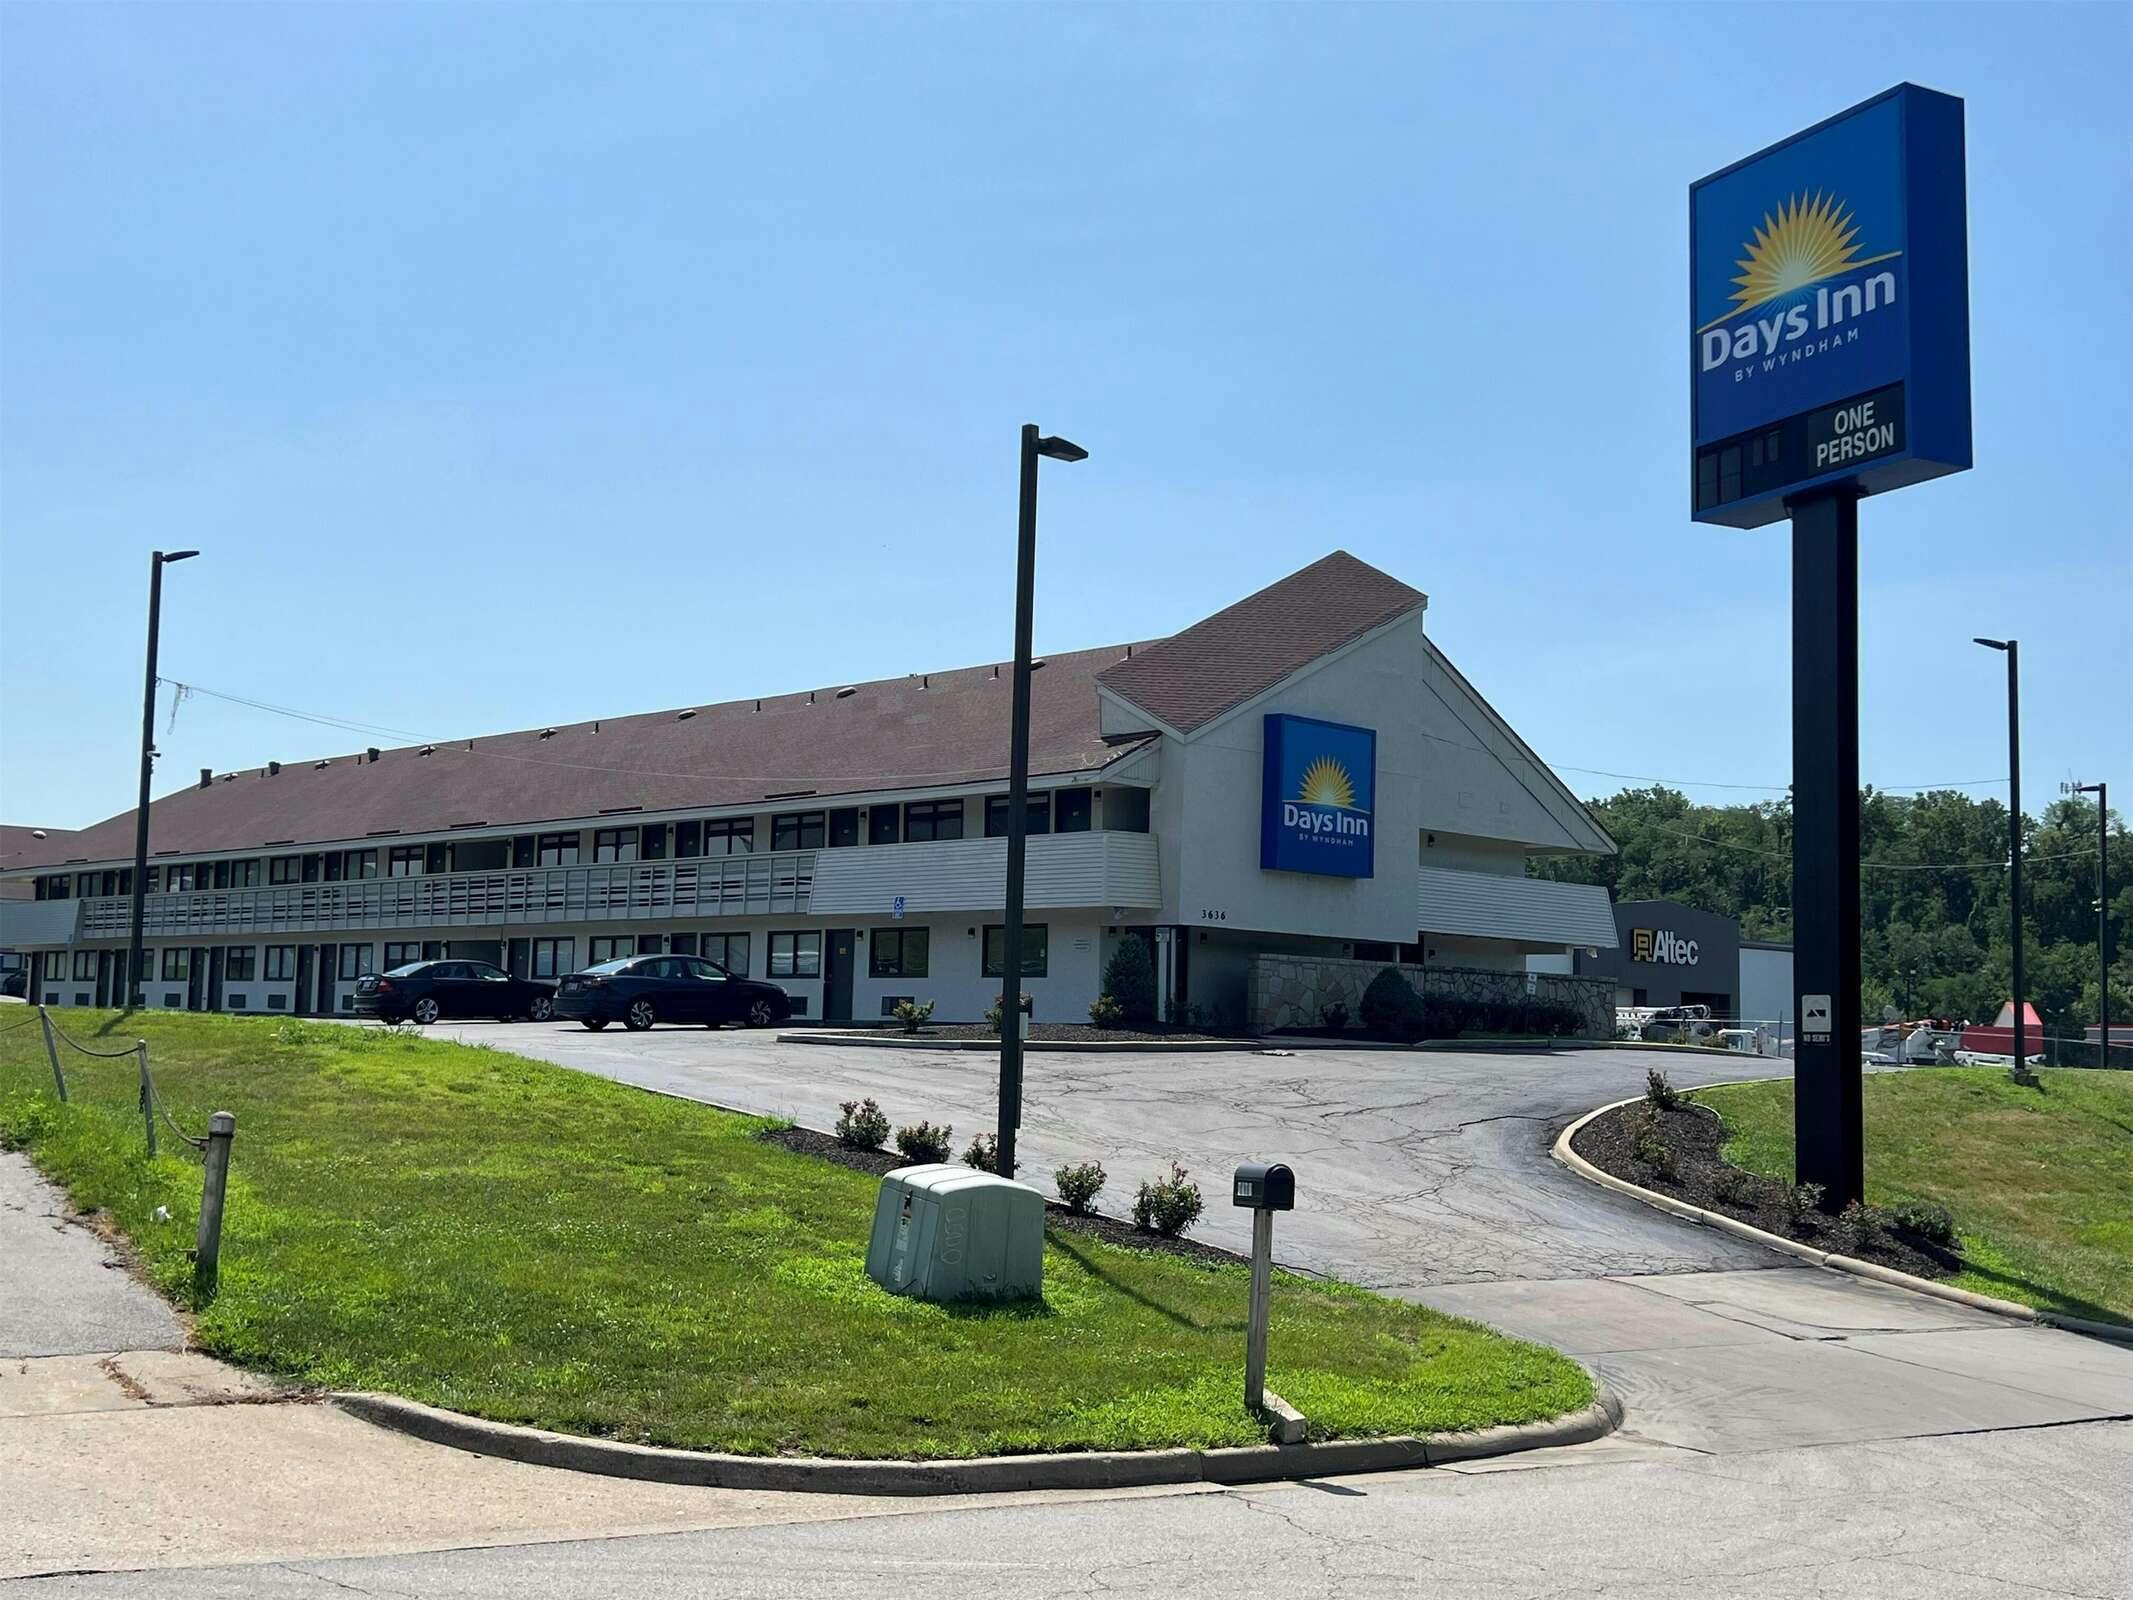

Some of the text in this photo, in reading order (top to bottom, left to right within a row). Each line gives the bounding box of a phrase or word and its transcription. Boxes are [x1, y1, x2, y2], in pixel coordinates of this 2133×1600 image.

[1702, 271, 1896, 373] Days Inn
[1735, 327, 1859, 383] BY WYNDHAM
[1834, 401, 1875, 434] ONE
[1816, 422, 1895, 468] PERSON
[1284, 803, 1368, 836] Days Inn
[1298, 832, 1354, 847] BY WYNDHAM
[1200, 909, 1226, 921] 3636
[1652, 929, 1699, 966] Altec
